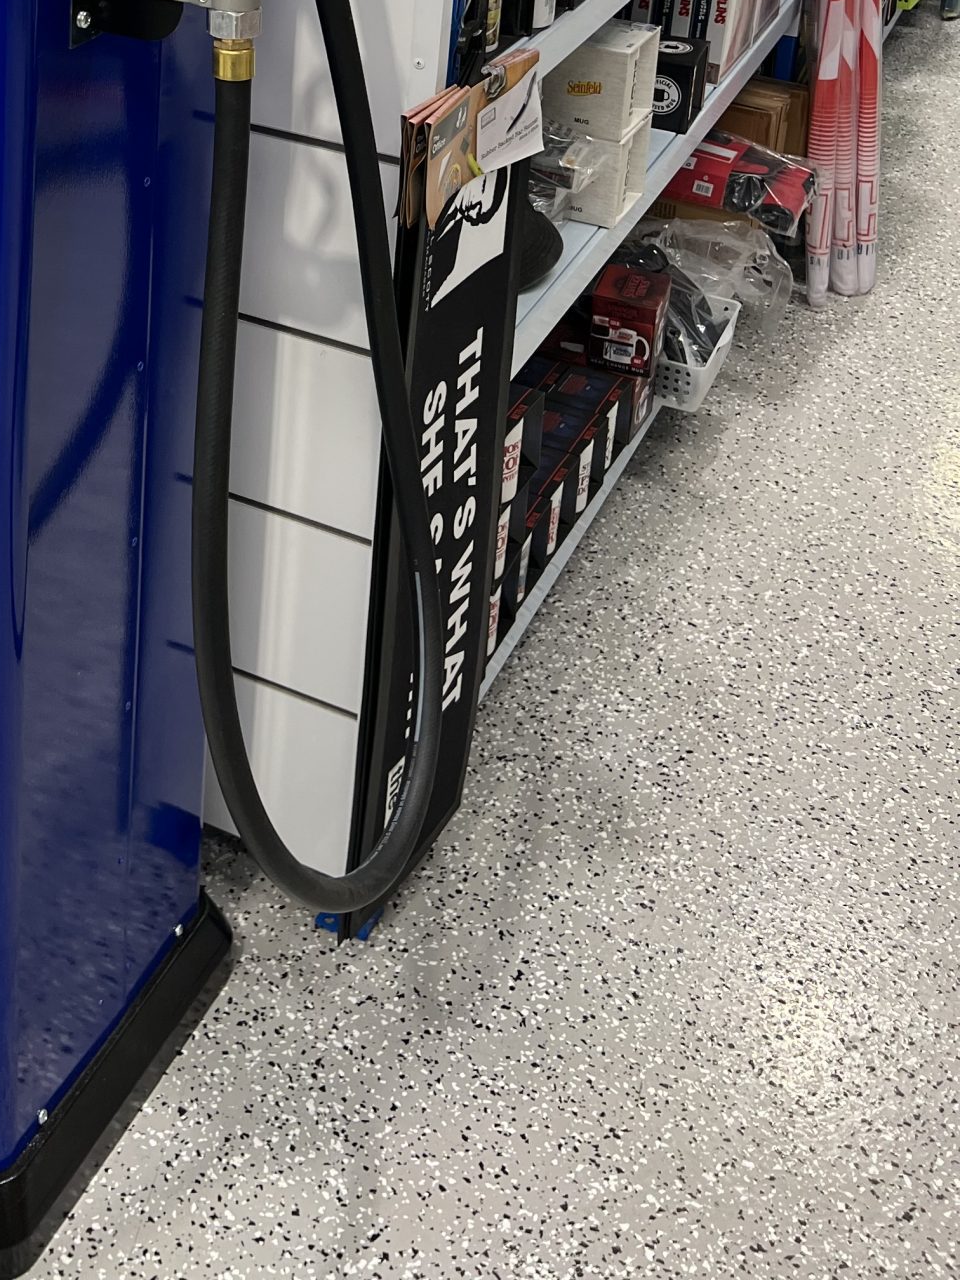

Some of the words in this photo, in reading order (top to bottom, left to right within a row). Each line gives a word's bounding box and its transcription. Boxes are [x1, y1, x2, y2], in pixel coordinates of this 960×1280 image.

[567, 80, 602, 96] Seinfeld
[574, 117, 589, 125] MUG
[453, 326, 484, 539] THAT'S
[441, 540, 474, 712] WHAT
